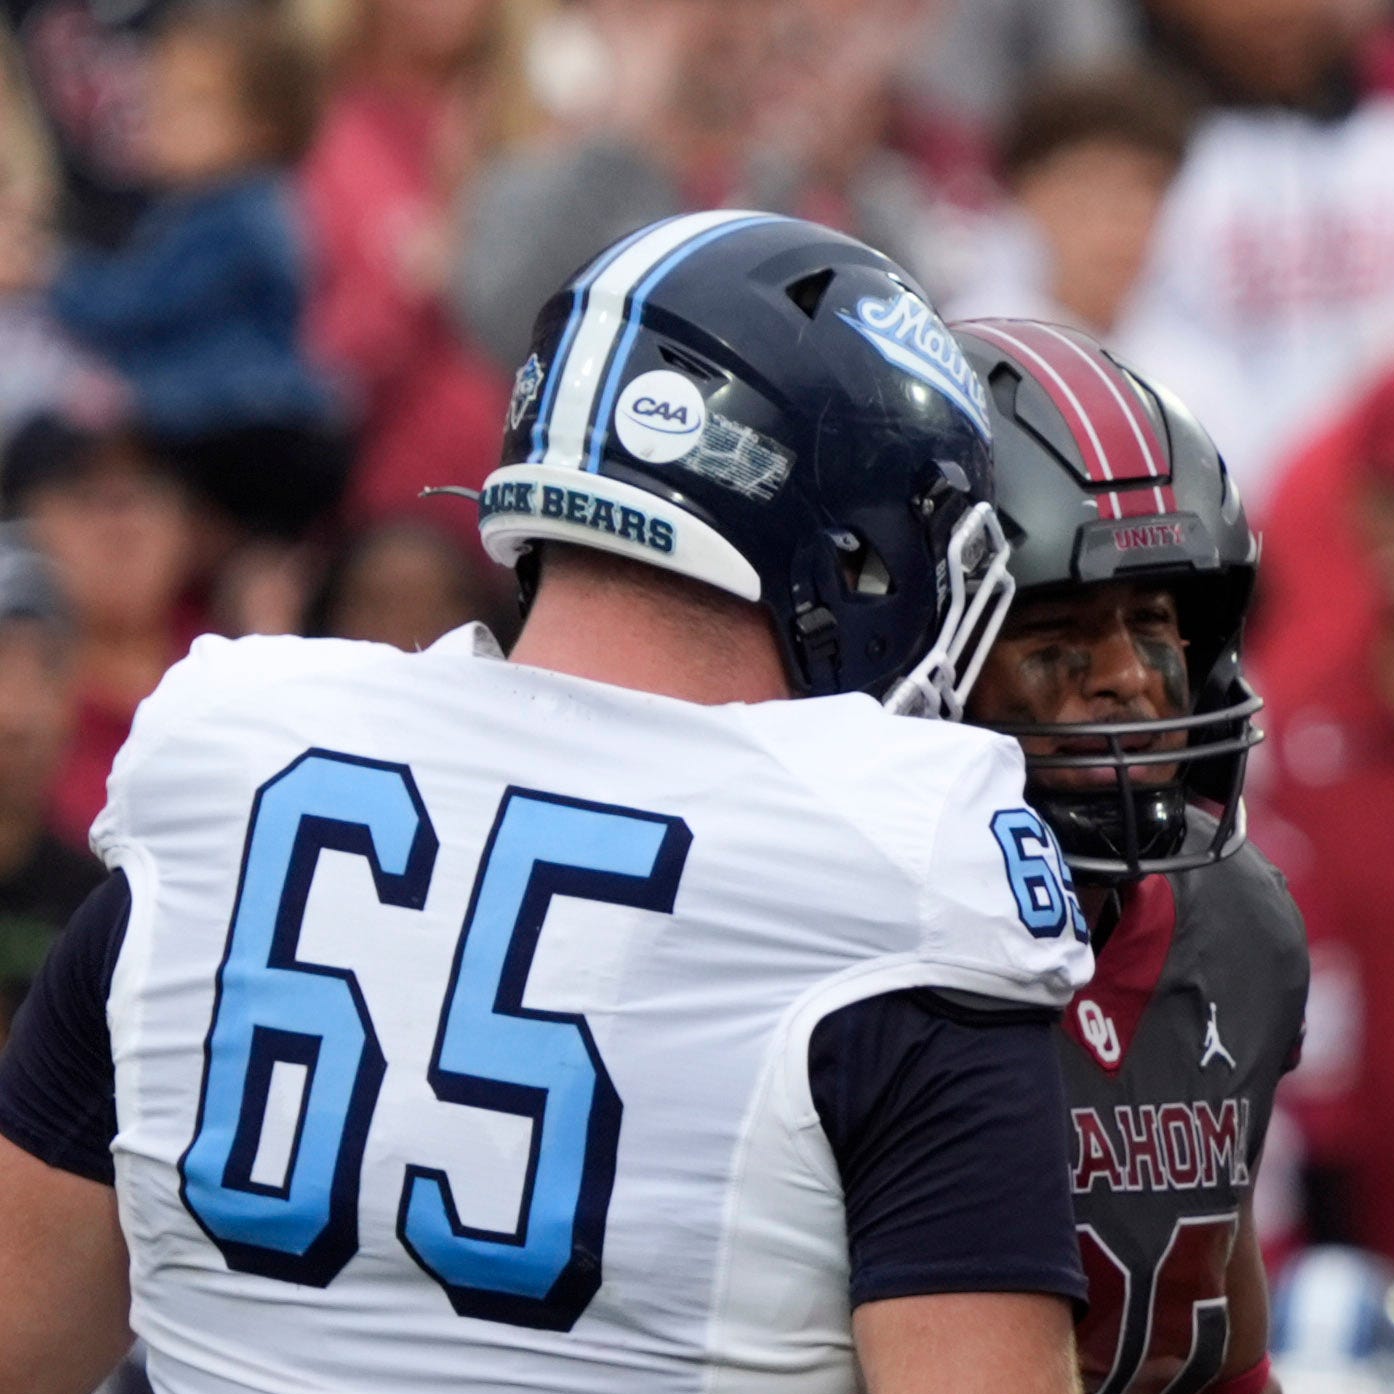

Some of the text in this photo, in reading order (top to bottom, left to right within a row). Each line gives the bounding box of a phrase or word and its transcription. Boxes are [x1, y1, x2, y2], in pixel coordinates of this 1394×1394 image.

[856, 291, 990, 414] Main
[632, 397, 689, 426] CAA
[479, 482, 676, 552] LACK BEARS
[1113, 523, 1184, 551] UNITY
[177, 746, 694, 1333] 65
[1077, 999, 1120, 1063] OU
